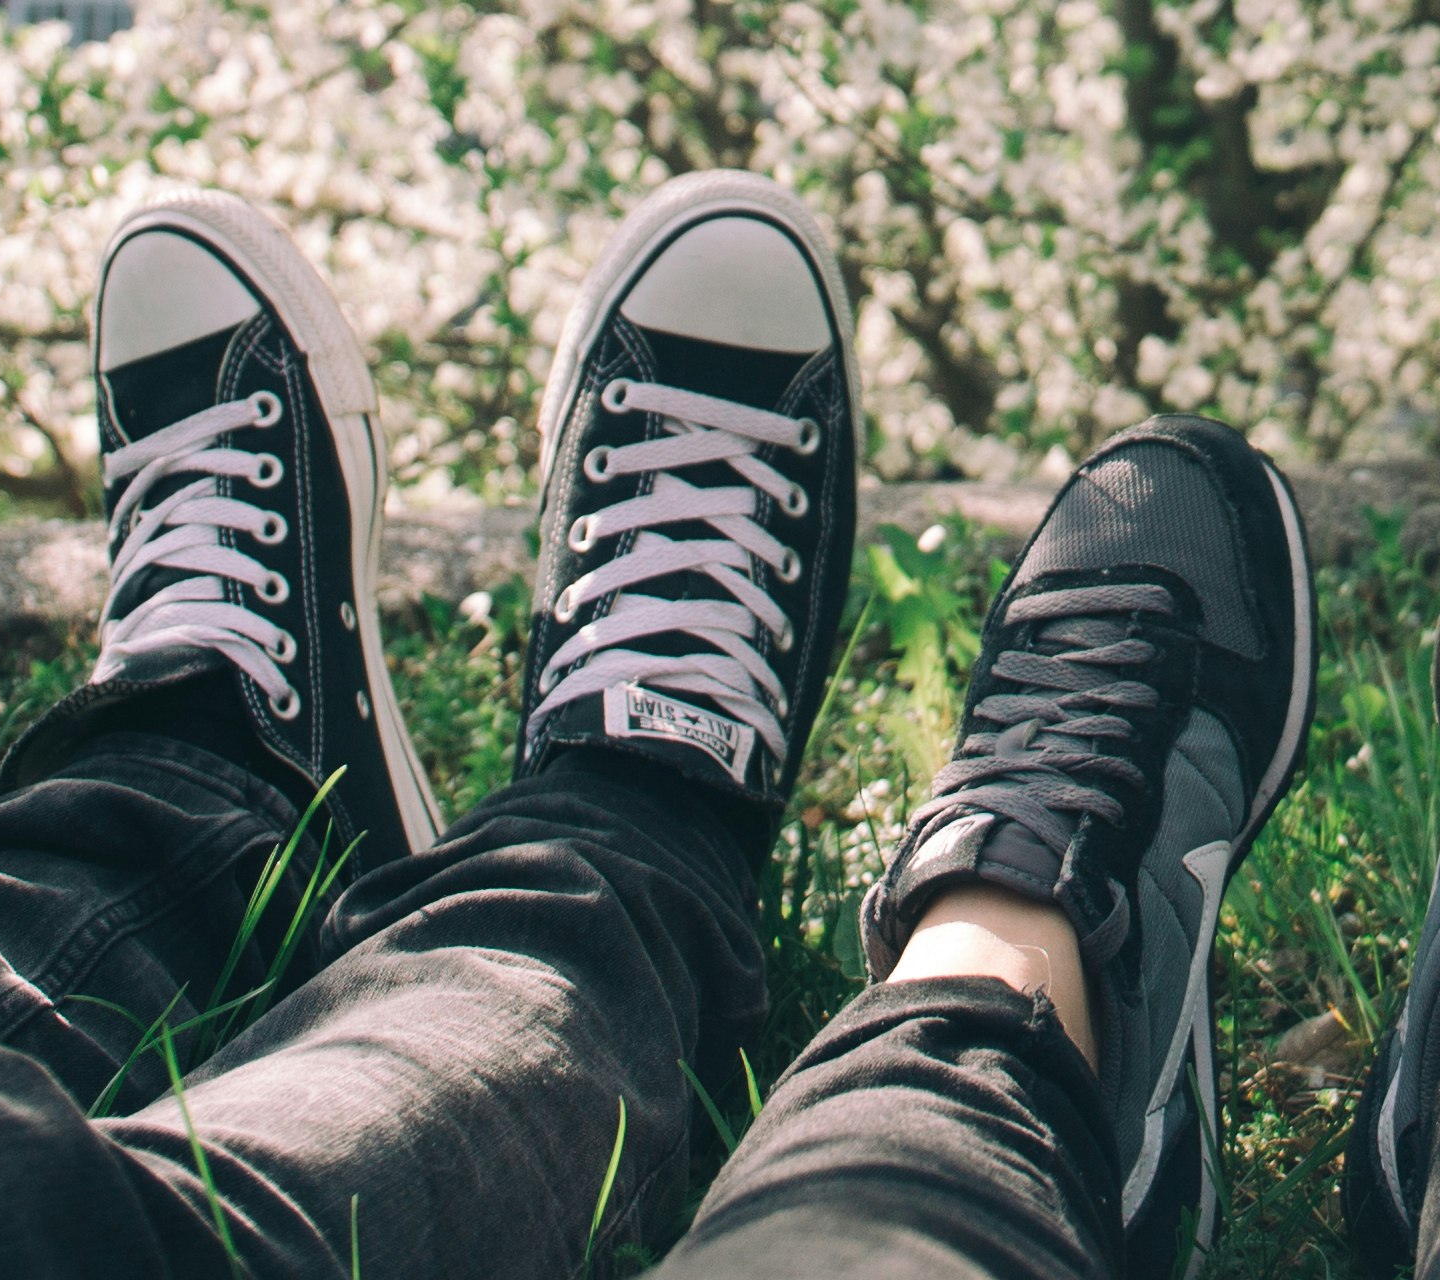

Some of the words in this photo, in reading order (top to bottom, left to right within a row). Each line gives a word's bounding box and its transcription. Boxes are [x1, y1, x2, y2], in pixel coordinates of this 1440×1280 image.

[632, 695, 676, 722] STAR
[639, 716, 728, 758] CONVEE
[707, 718, 734, 742] ALL
